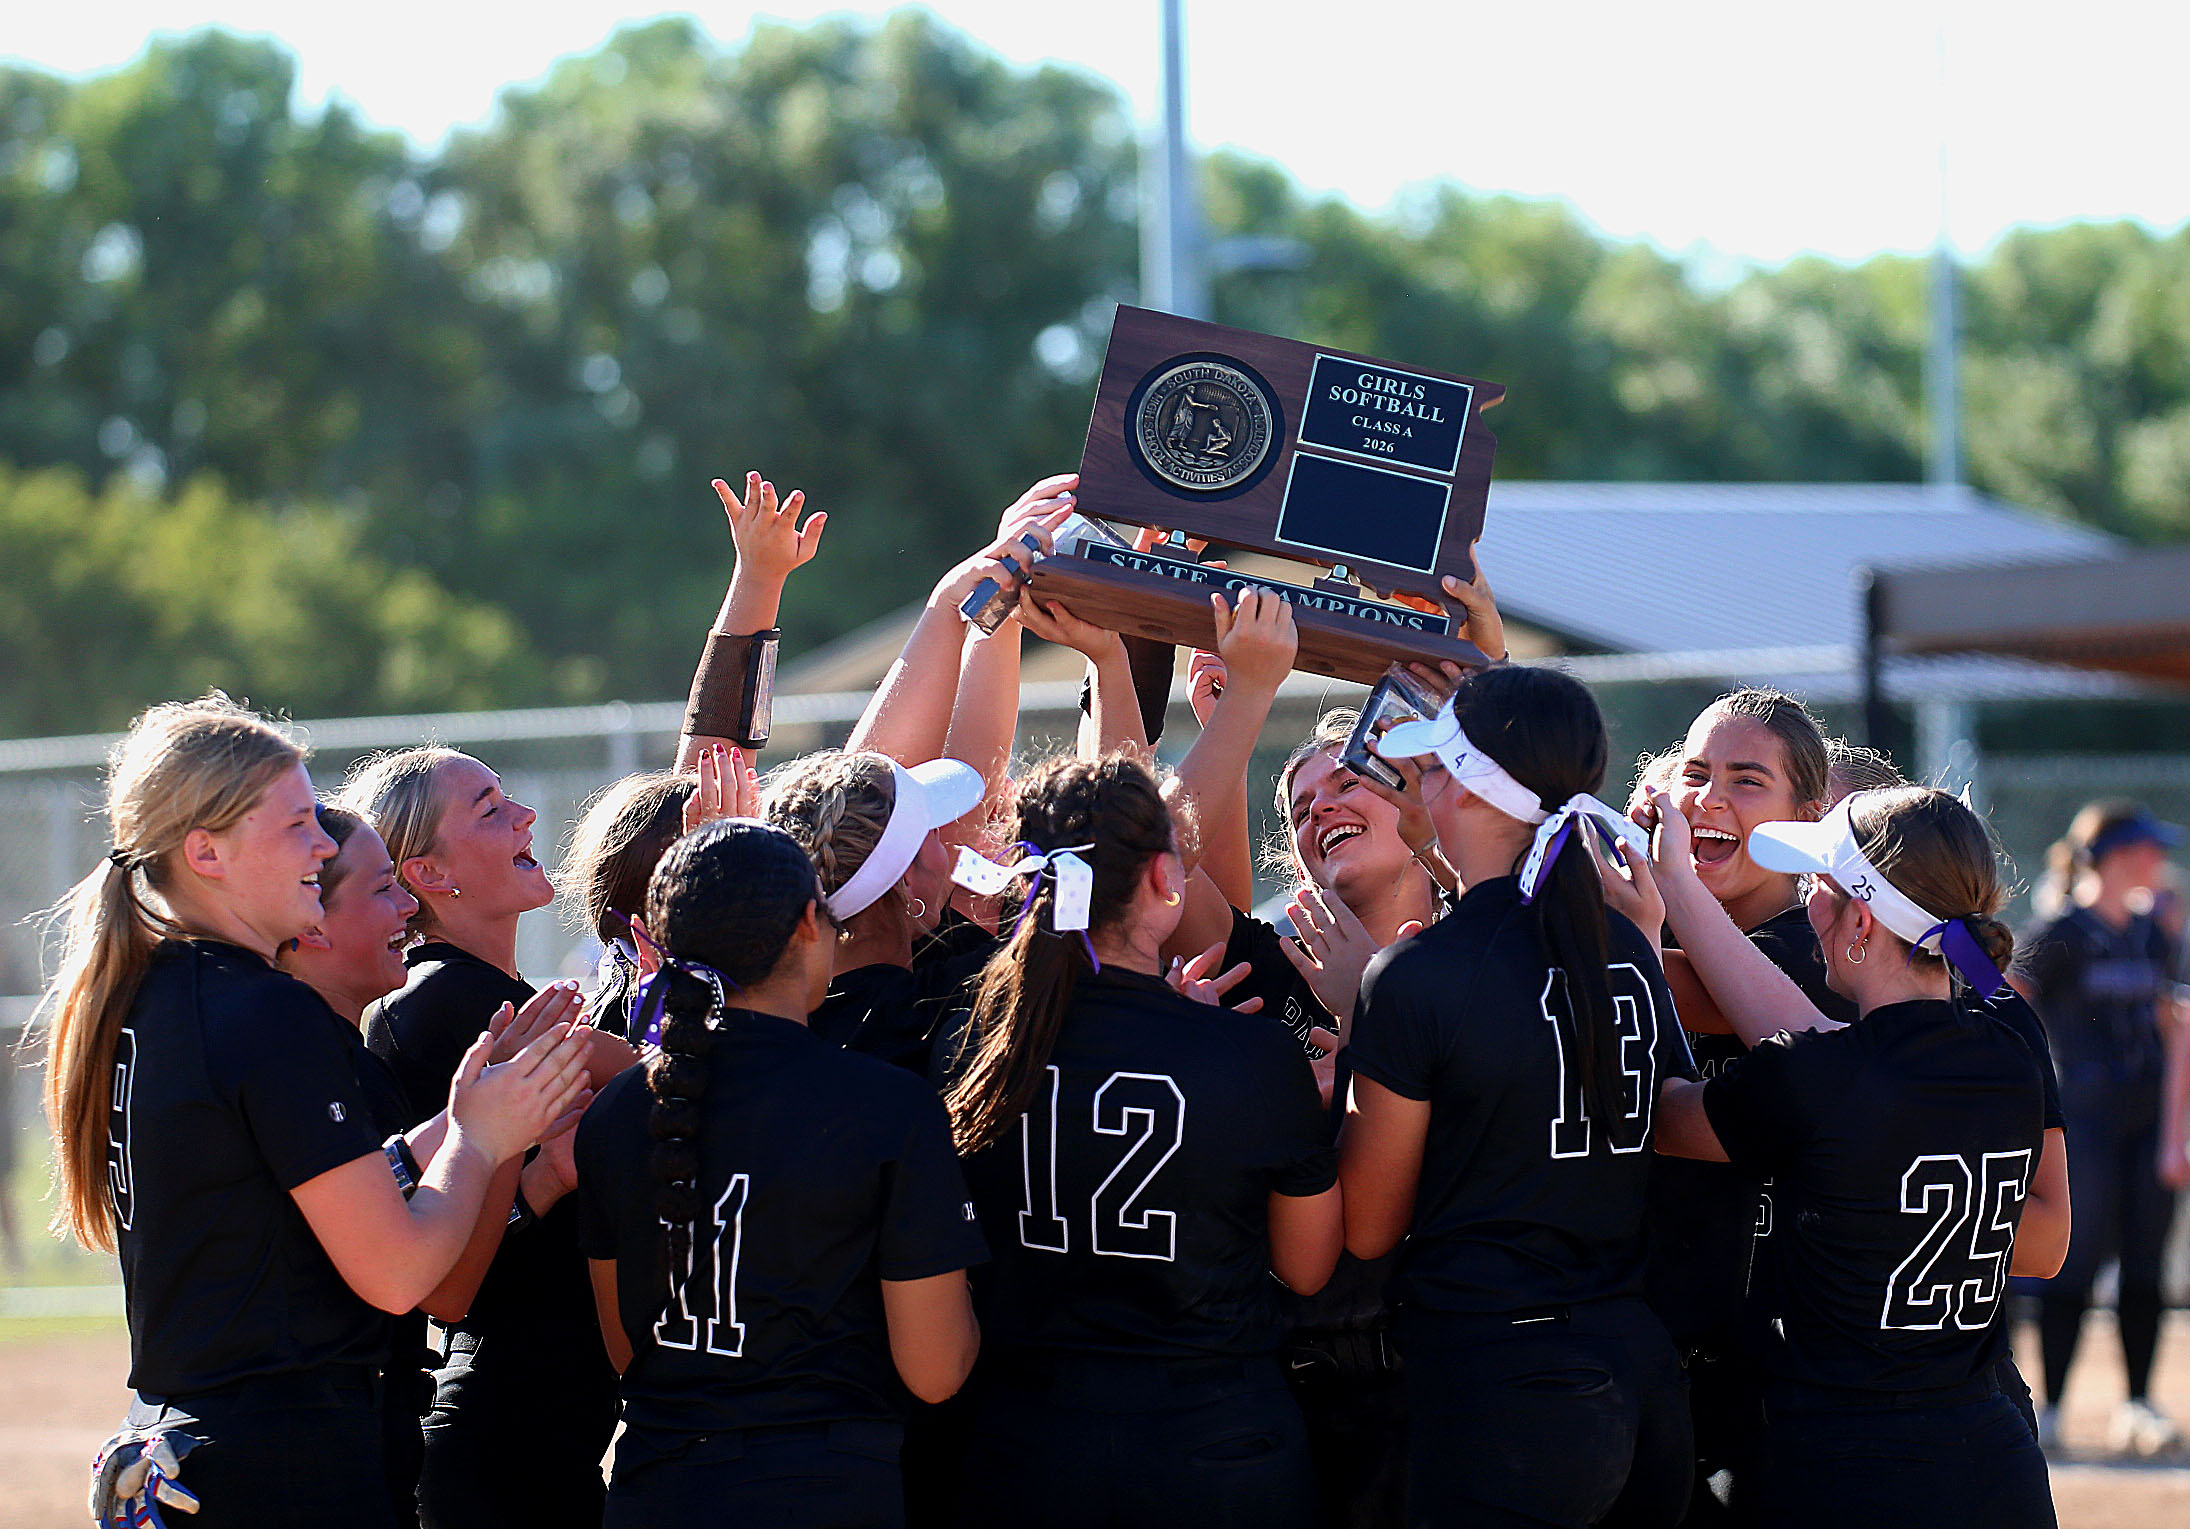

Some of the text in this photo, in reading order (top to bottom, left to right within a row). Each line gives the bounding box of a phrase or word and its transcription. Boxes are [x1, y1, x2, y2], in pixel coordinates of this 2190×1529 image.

[1166, 368, 1258, 406] SOUTH DAKOTA
[1329, 385, 1446, 424] SOFTBALL
[1358, 373, 1426, 400] GIRLS
[1143, 392, 1265, 483] HIGH SCHOOL ACTIVITIES ASSOCIATION
[1352, 415, 1413, 438] CLASS A
[1363, 437, 1395, 453] 2026
[1851, 874, 1877, 902] 25
[1539, 962, 1658, 1160] 13
[1019, 1064, 1186, 1262] 12
[1880, 1148, 2032, 1331] 25
[653, 1173, 749, 1358] 11
